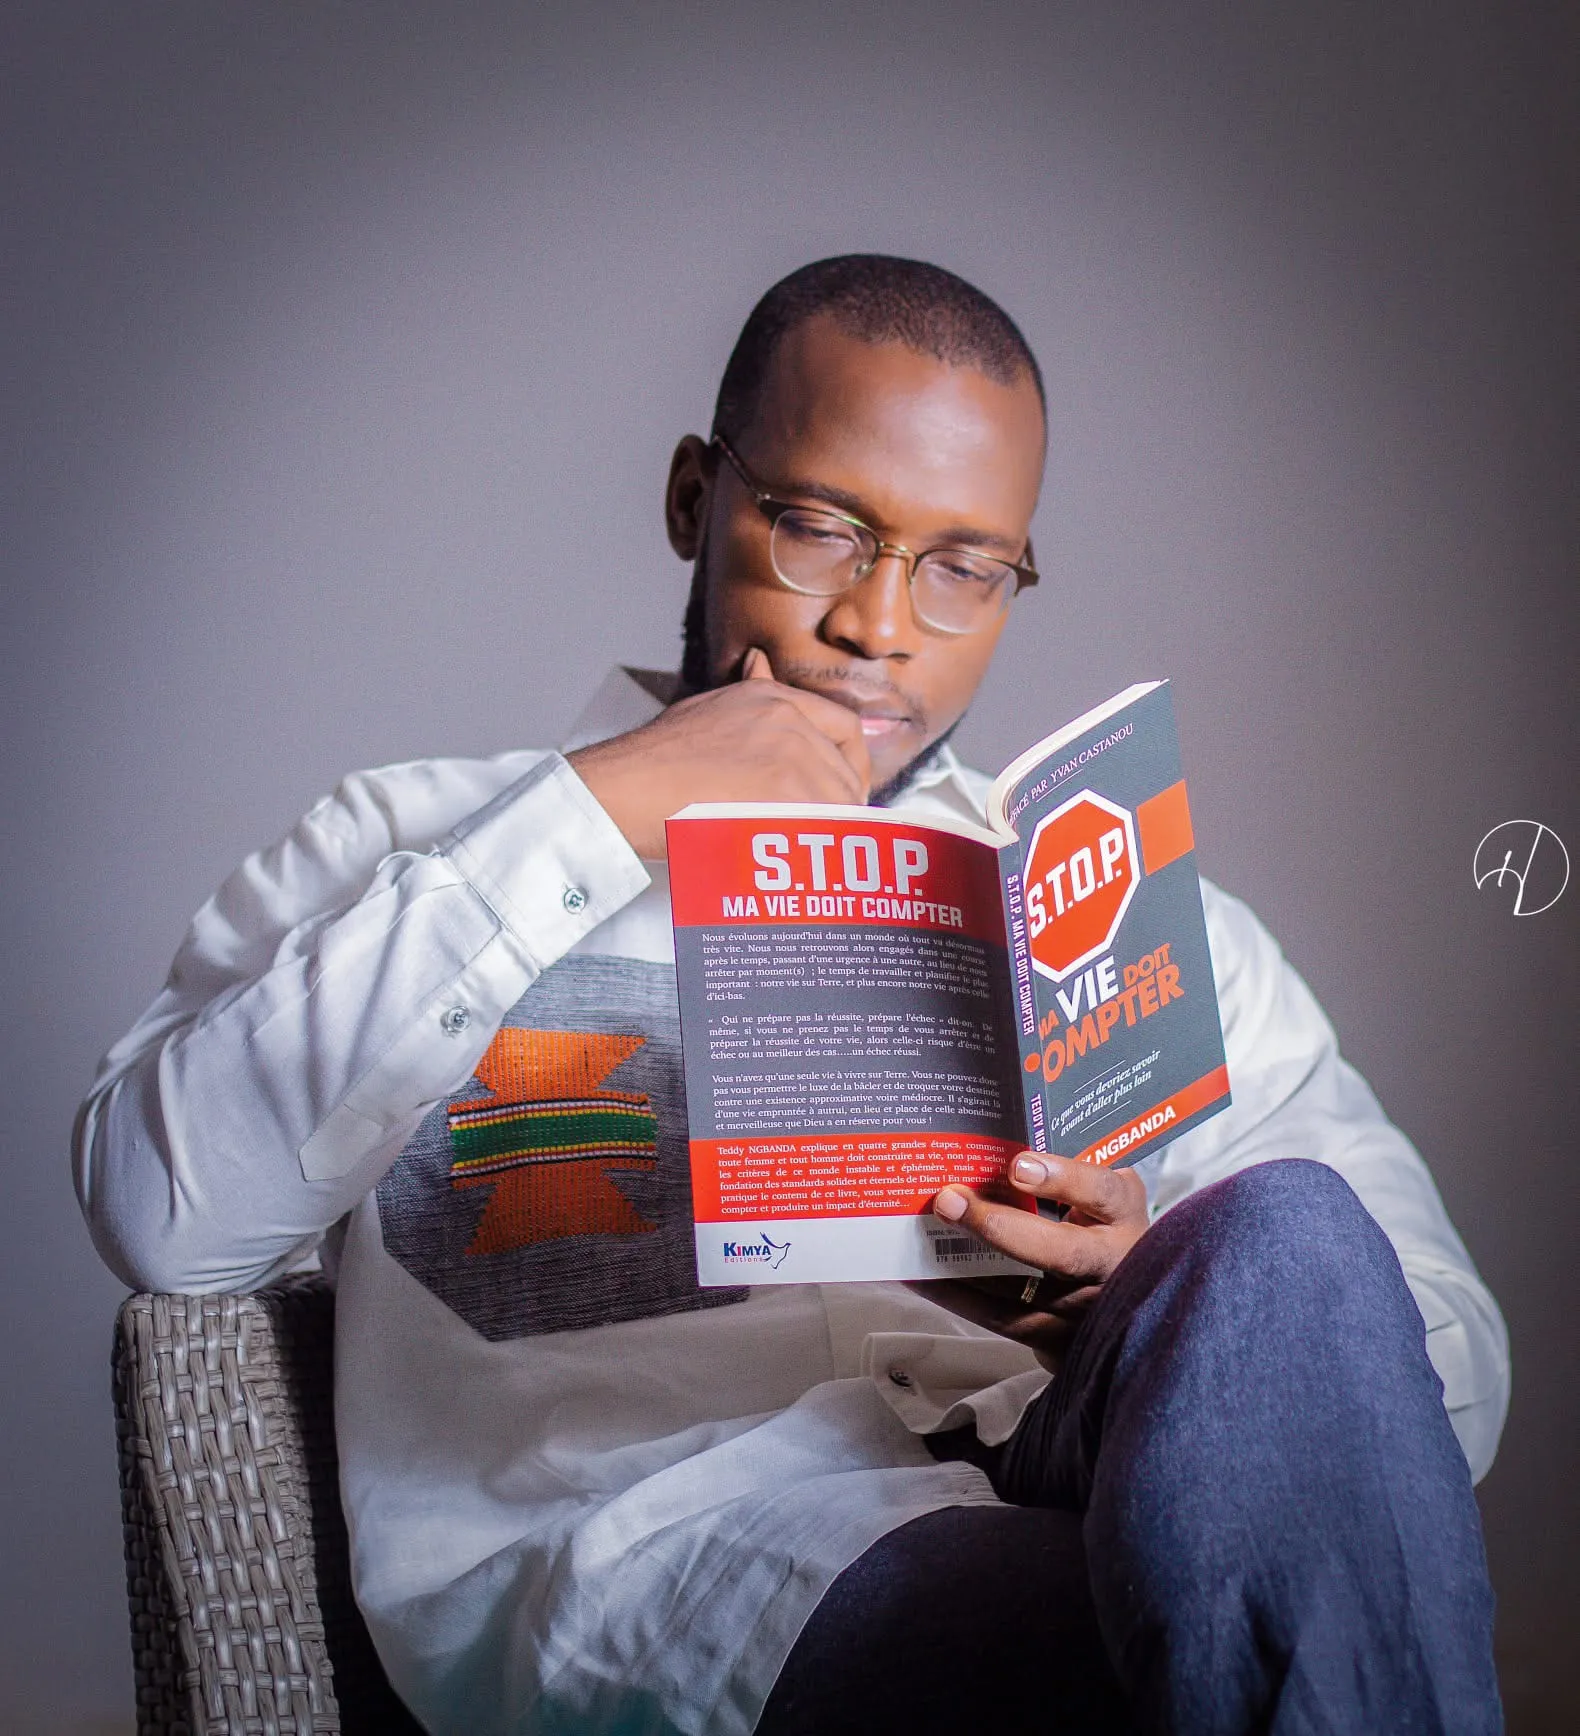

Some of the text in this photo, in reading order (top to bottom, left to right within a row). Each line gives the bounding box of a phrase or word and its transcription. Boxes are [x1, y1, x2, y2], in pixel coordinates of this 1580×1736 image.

[1031, 779, 1048, 799] PAR
[1050, 757, 1078, 783] YVAN
[1079, 723, 1134, 764] CASTANOU
[751, 833, 929, 897] S.T.O.P.
[1026, 827, 1125, 939] S.T.O.P.
[722, 895, 963, 927] MA VIE DOIT COMPTER
[1012, 919, 1024, 940] MA
[728, 933, 768, 941] évoluons
[912, 936, 930, 944] tout
[704, 946, 720, 954] très
[853, 944, 874, 952] alors
[879, 946, 914, 955] engagés
[918, 948, 938, 956] dans
[1015, 940, 1027, 959] VIE
[704, 957, 728, 967] après
[741, 957, 770, 966] temps,
[773, 956, 806, 967] passant
[808, 955, 832, 963] d'une
[836, 956, 870, 966] urgence
[899, 958, 924, 967] autre,
[1123, 942, 1171, 987] DOIT
[705, 967, 960, 981] arrêter moment(s) temps travailler planifier
[1016, 957, 1029, 984] DOIT
[706, 981, 750, 990] important
[818, 979, 844, 987] Terre,
[857, 978, 875, 988] plus
[878, 980, 906, 988] encore
[909, 981, 932, 989] notre
[949, 985, 970, 995] après
[1055, 955, 1119, 1023] VIE
[706, 992, 745, 1001] d'ici-bas.
[1019, 983, 1035, 1036] COMPTER
[758, 1013, 935, 1024] prépare réussite, prépare l'échec
[709, 1028, 739, 1036] même,
[798, 1026, 828, 1035] prenez
[867, 1025, 894, 1034] temps
[710, 1039, 748, 1049] préparer
[765, 1038, 799, 1046] réussite
[867, 1036, 888, 1044] alors
[892, 1036, 923, 1045] celle-ci
[928, 1039, 954, 1048] risque
[711, 1048, 921, 1059] échec meilleur échec réussi.
[712, 1071, 978, 1085] Vous n'avez qu'une seule vivre Terre. Vous pouvez
[754, 1085, 796, 1095] permettre
[809, 1083, 828, 1091] luxe
[854, 1082, 881, 1090] bâcler
[907, 1084, 939, 1092] troquer
[966, 1085, 1000, 1097] destinée
[1051, 1050, 1161, 1131] Ce que vous devriez savoir
[765, 1096, 806, 1105] existence
[809, 1094, 873, 1104] approximative
[876, 1094, 898, 1102] voire
[902, 1093, 944, 1102] médiocre.
[1061, 1071, 1152, 1137] avant d'aller plus loin
[715, 1110, 739, 1118] d'une
[758, 1107, 806, 1118] empruntée
[818, 1106, 847, 1115] autrui,
[864, 1105, 881, 1114] lieu
[895, 1105, 918, 1114] place
[935, 1105, 955, 1114] celle
[727, 1120, 782, 1130] merveilleuse
[882, 1118, 903, 1126] pour
[1031, 1094, 1047, 1153] TEDDY NGB
[1095, 1105, 1176, 1165] NGBANDA
[716, 1140, 1004, 1156] Teddy NGBANDA explique quatre grandes étapes, comment
[745, 1158, 775, 1166] femme
[790, 1156, 808, 1164] tout
[811, 1155, 844, 1163] homme
[847, 1153, 864, 1162] doit
[868, 1152, 912, 1160] construire
[984, 1155, 1005, 1164] selon
[738, 1169, 770, 1177] critères
[809, 1166, 839, 1175] monde
[845, 1165, 880, 1173] instable
[901, 1164, 948, 1172] éphémère,
[720, 1175, 940, 1190] fondation standards solides éternels Dieu
[721, 1194, 758, 1204] pratique
[772, 1192, 808, 1200] contenu
[838, 1189, 860, 1198] livre,
[721, 1206, 758, 1214] compter
[771, 1202, 809, 1214] produire
[826, 1202, 856, 1211] impact
[724, 1242, 771, 1256] KIMYA
